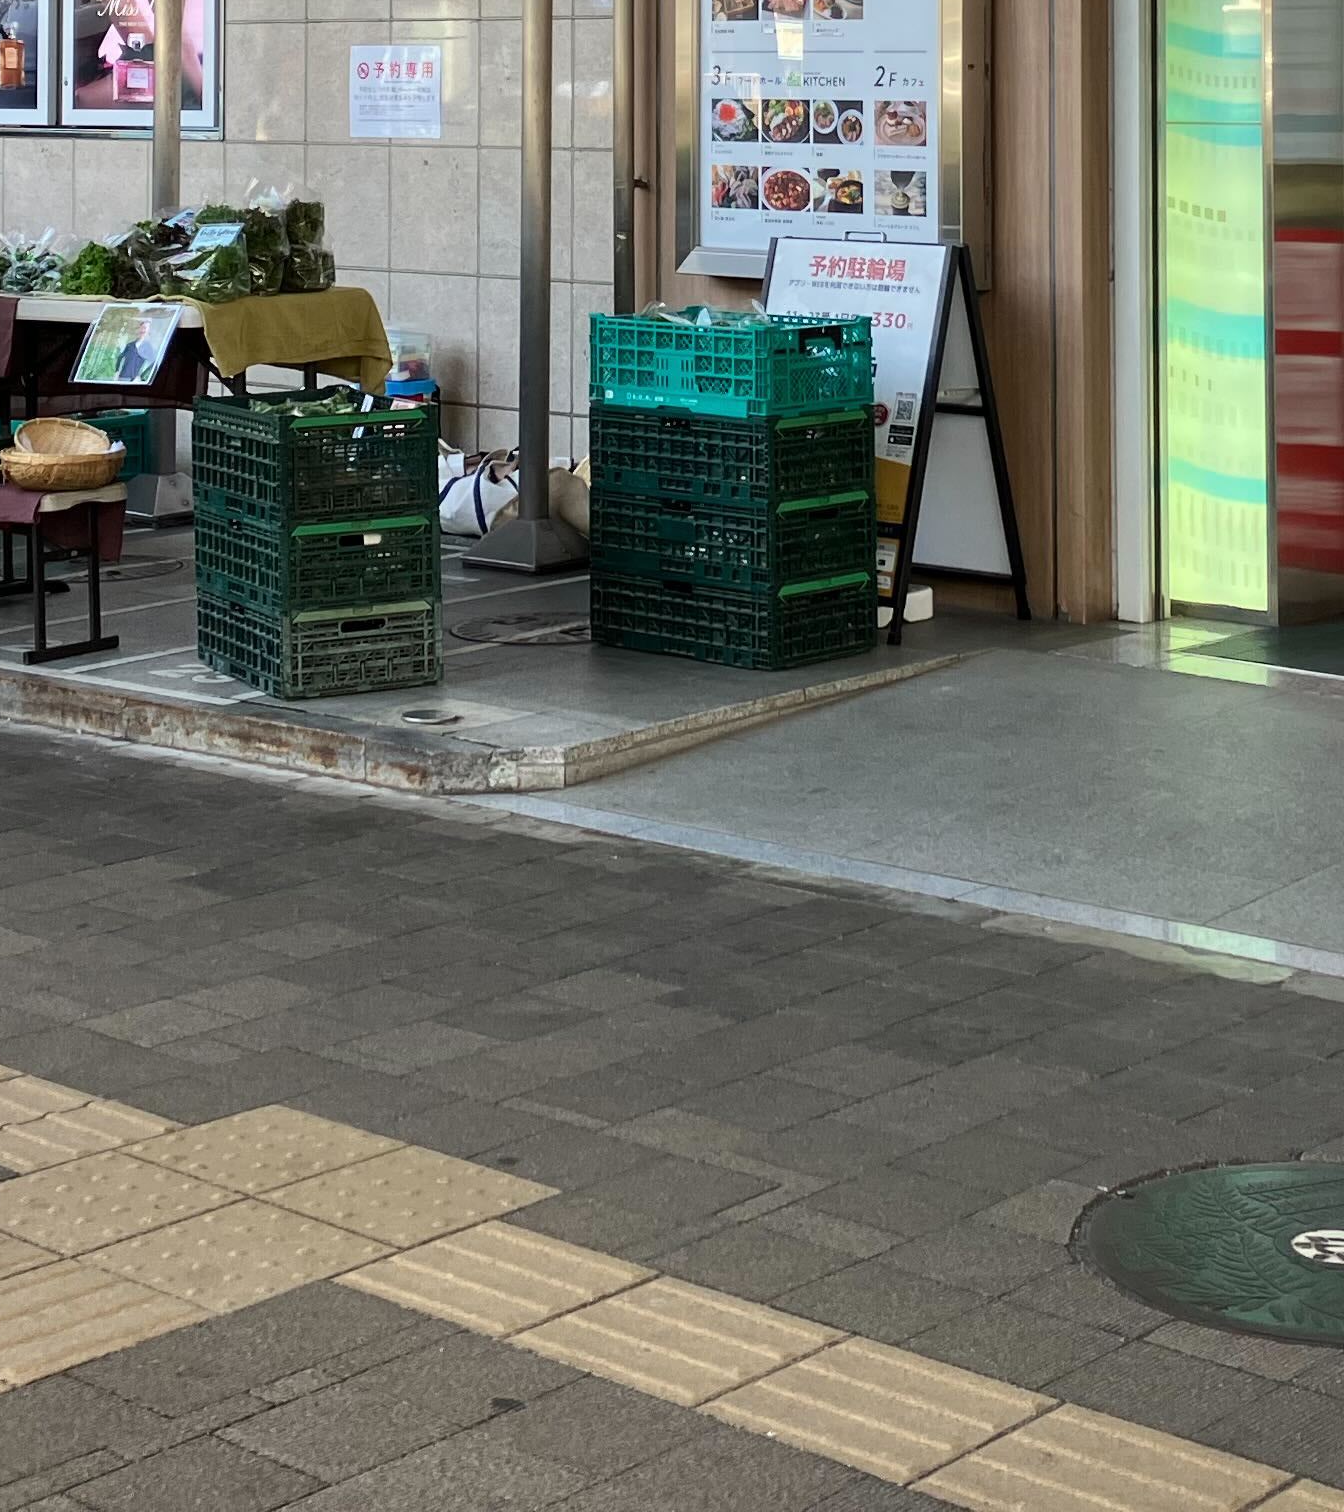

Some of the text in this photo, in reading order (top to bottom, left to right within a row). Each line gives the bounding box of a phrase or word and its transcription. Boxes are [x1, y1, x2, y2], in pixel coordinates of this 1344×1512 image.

[373, 61, 434, 80] 予約専用
[803, 76, 846, 88] KITCHEN
[809, 255, 906, 282] 予約駐輪場
